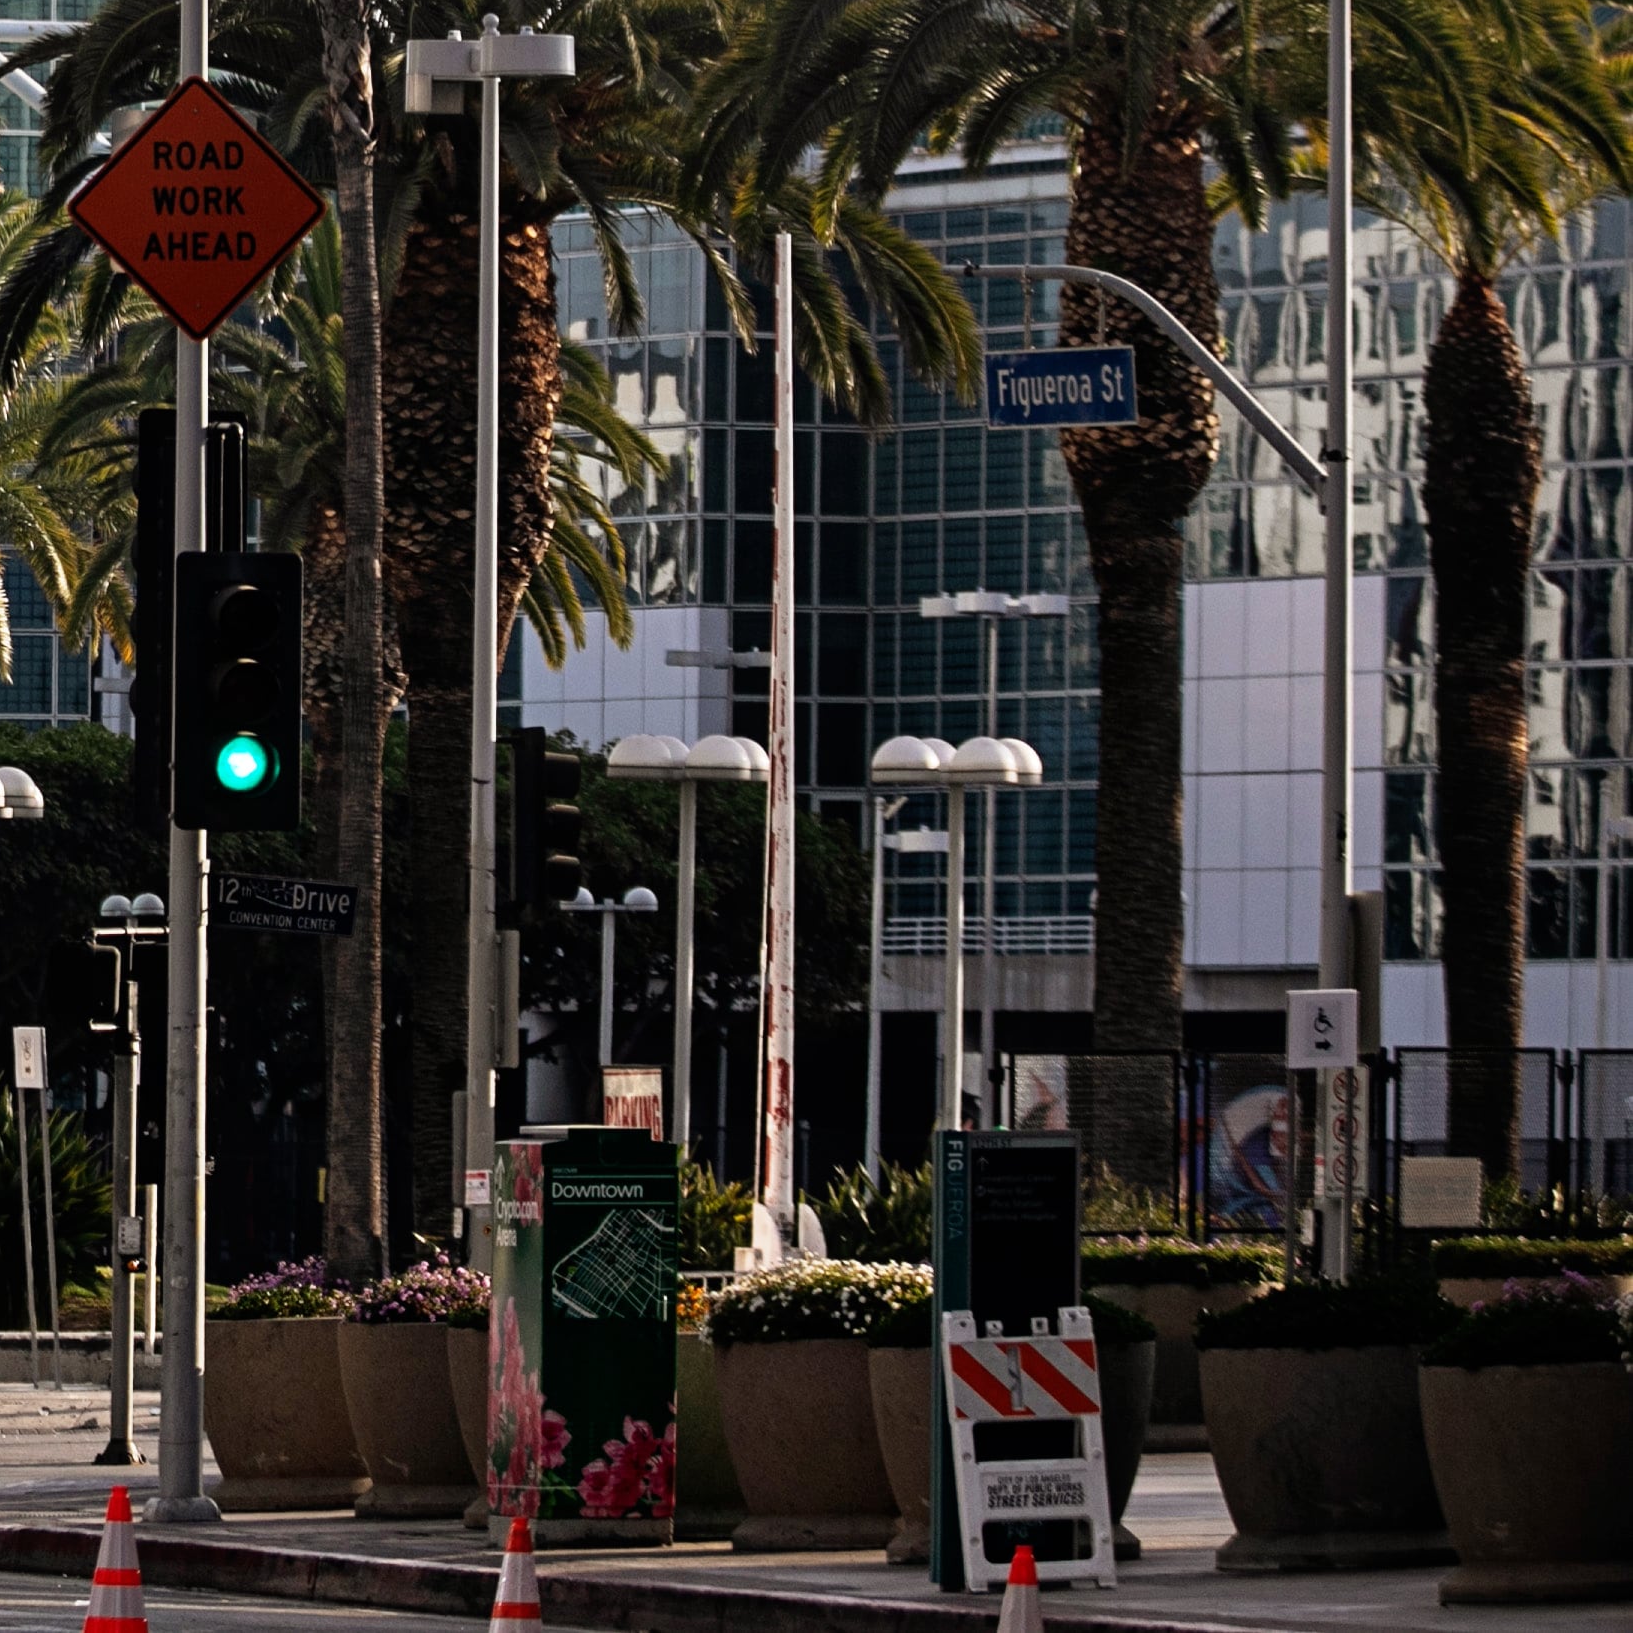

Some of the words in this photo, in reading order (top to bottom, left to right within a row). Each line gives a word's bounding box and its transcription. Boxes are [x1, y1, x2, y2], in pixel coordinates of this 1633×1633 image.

[153, 142, 244, 170] ROAD
[152, 187, 245, 216] WORK
[143, 232, 256, 261] AHEAD
[997, 369, 1093, 418] Figueroa
[1101, 364, 1124, 403] St
[218, 878, 252, 904] 12th
[293, 884, 350, 914] Drive
[230, 911, 292, 927] CONVENTION
[297, 917, 336, 931] CENTER
[552, 1181, 643, 1199] Downtown
[947, 1140, 964, 1240] FIGUEROA
[496, 1197, 539, 1224] Crypto.com
[497, 1225, 517, 1247] Arena
[988, 1486, 1008, 1494] DEPT.
[1012, 1485, 1022, 1494] OF
[1025, 1484, 1052, 1493] PUBLIC
[1055, 1483, 1083, 1492] WORKS
[988, 1495, 1029, 1508] STREET
[1032, 1492, 1085, 1508] SERVICES
